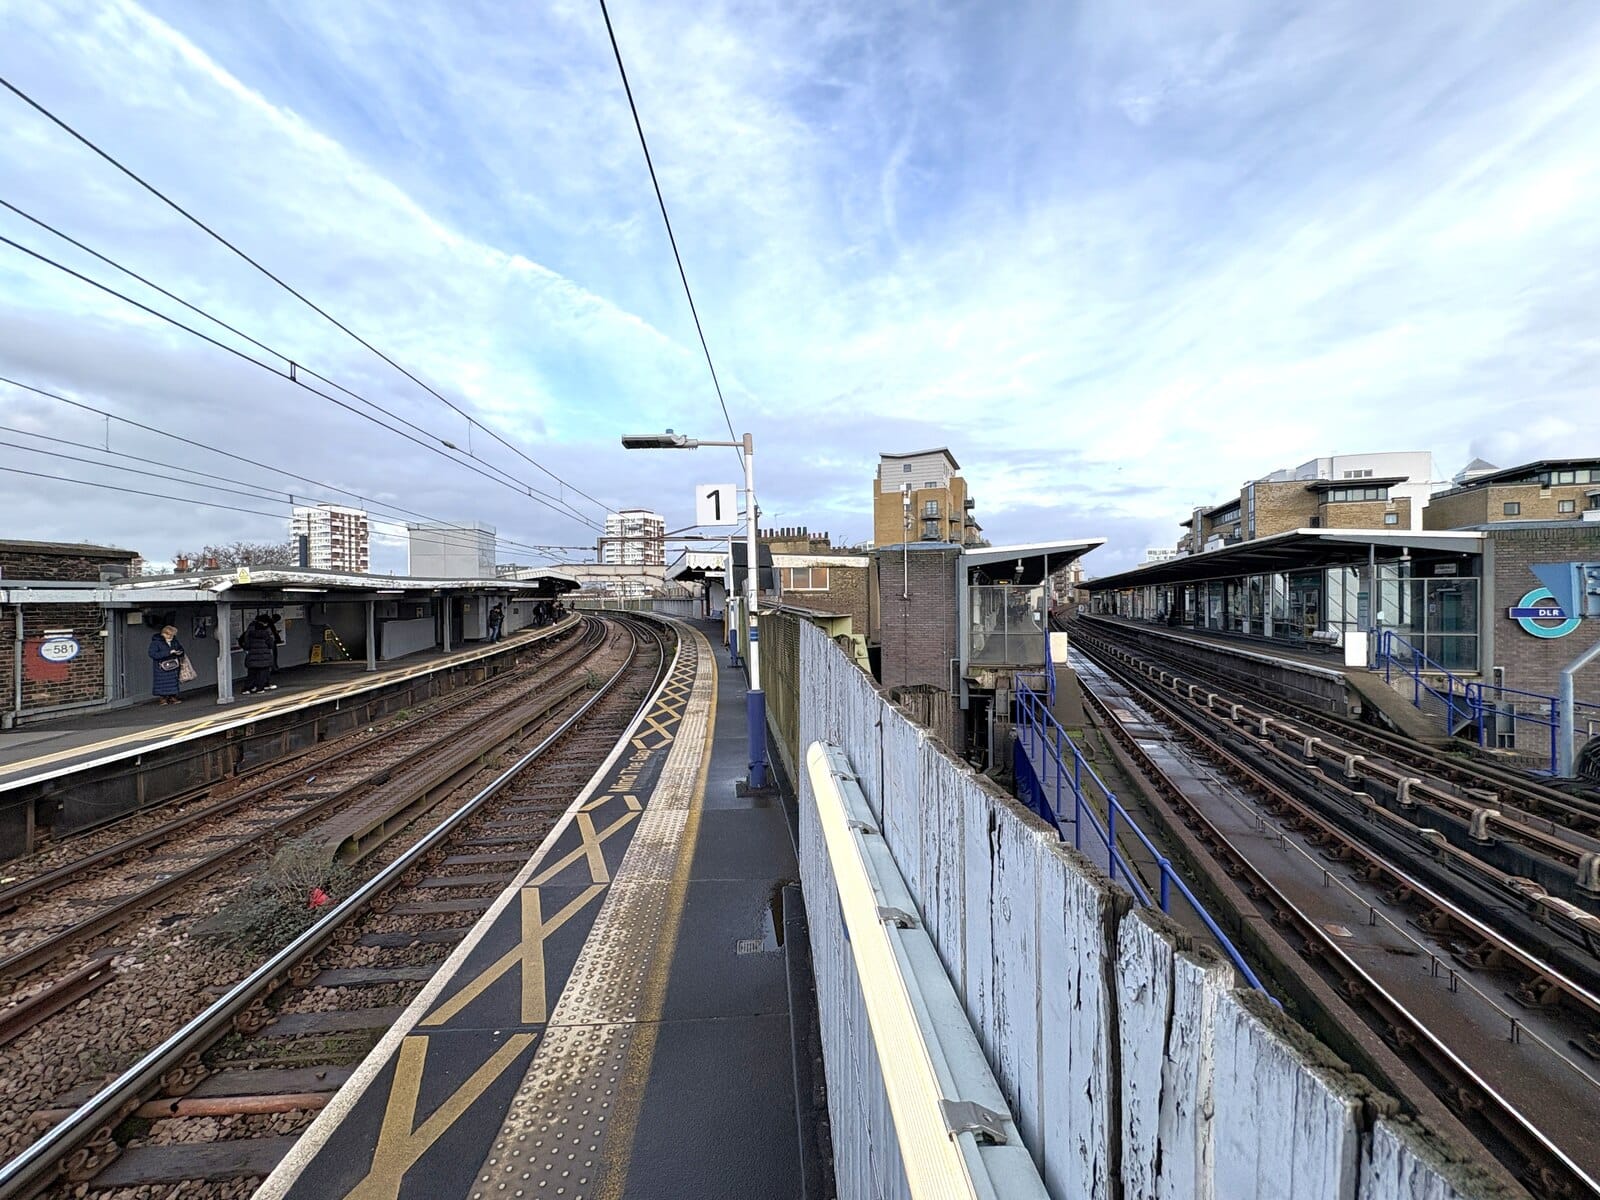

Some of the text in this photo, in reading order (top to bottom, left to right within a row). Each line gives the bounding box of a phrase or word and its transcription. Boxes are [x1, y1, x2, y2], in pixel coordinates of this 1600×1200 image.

[706, 489, 721, 521] 1
[1538, 609, 1560, 617] DLR
[53, 644, 74, 654] 581
[607, 749, 655, 792] Mind The Gap
